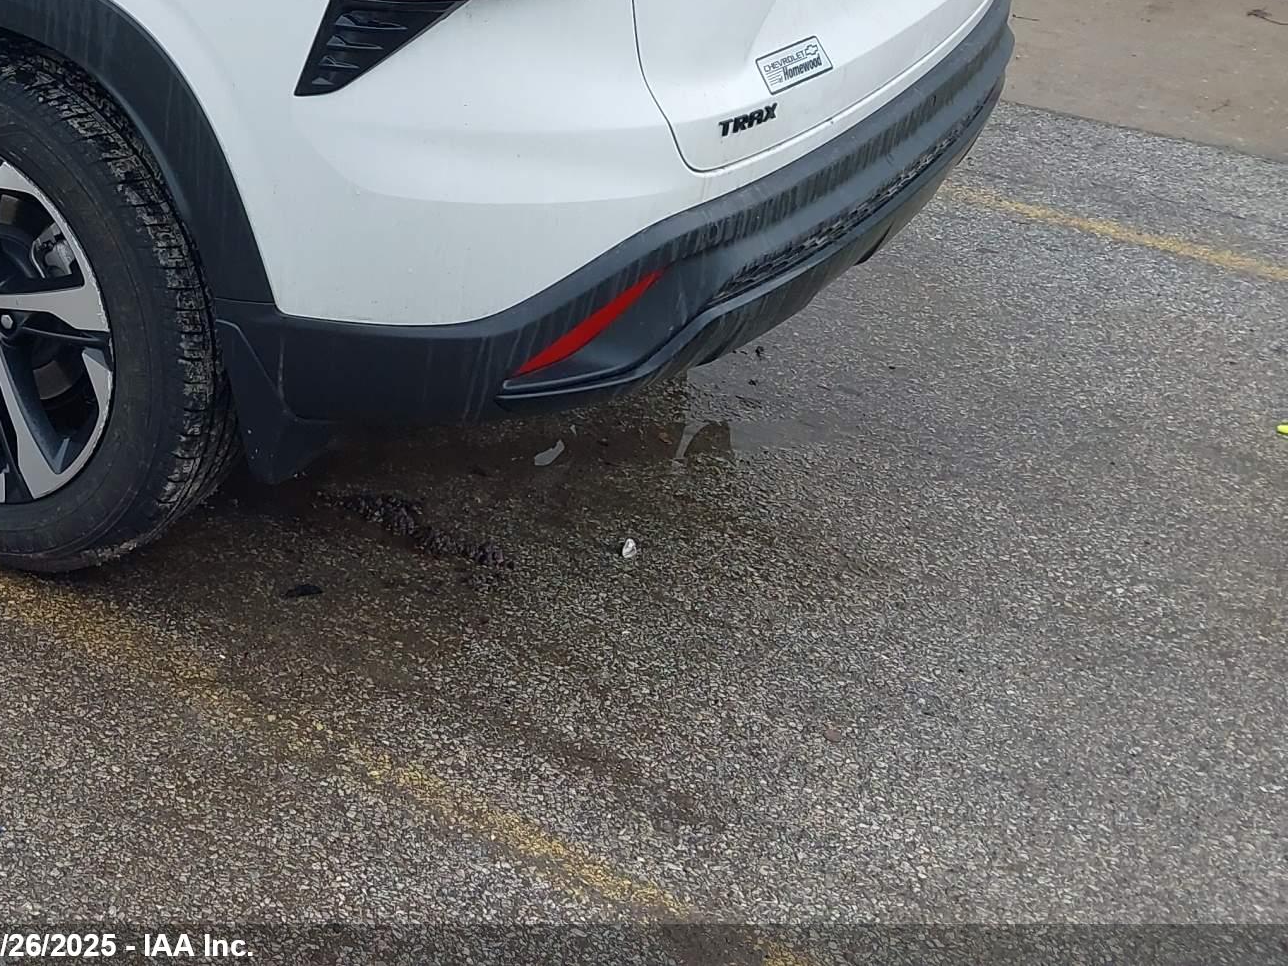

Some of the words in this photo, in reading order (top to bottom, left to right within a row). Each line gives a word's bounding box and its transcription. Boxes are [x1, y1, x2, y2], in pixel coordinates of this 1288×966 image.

[763, 49, 806, 73] CHEVROLET
[782, 52, 823, 81] Homewood
[718, 102, 778, 137] TRAX
